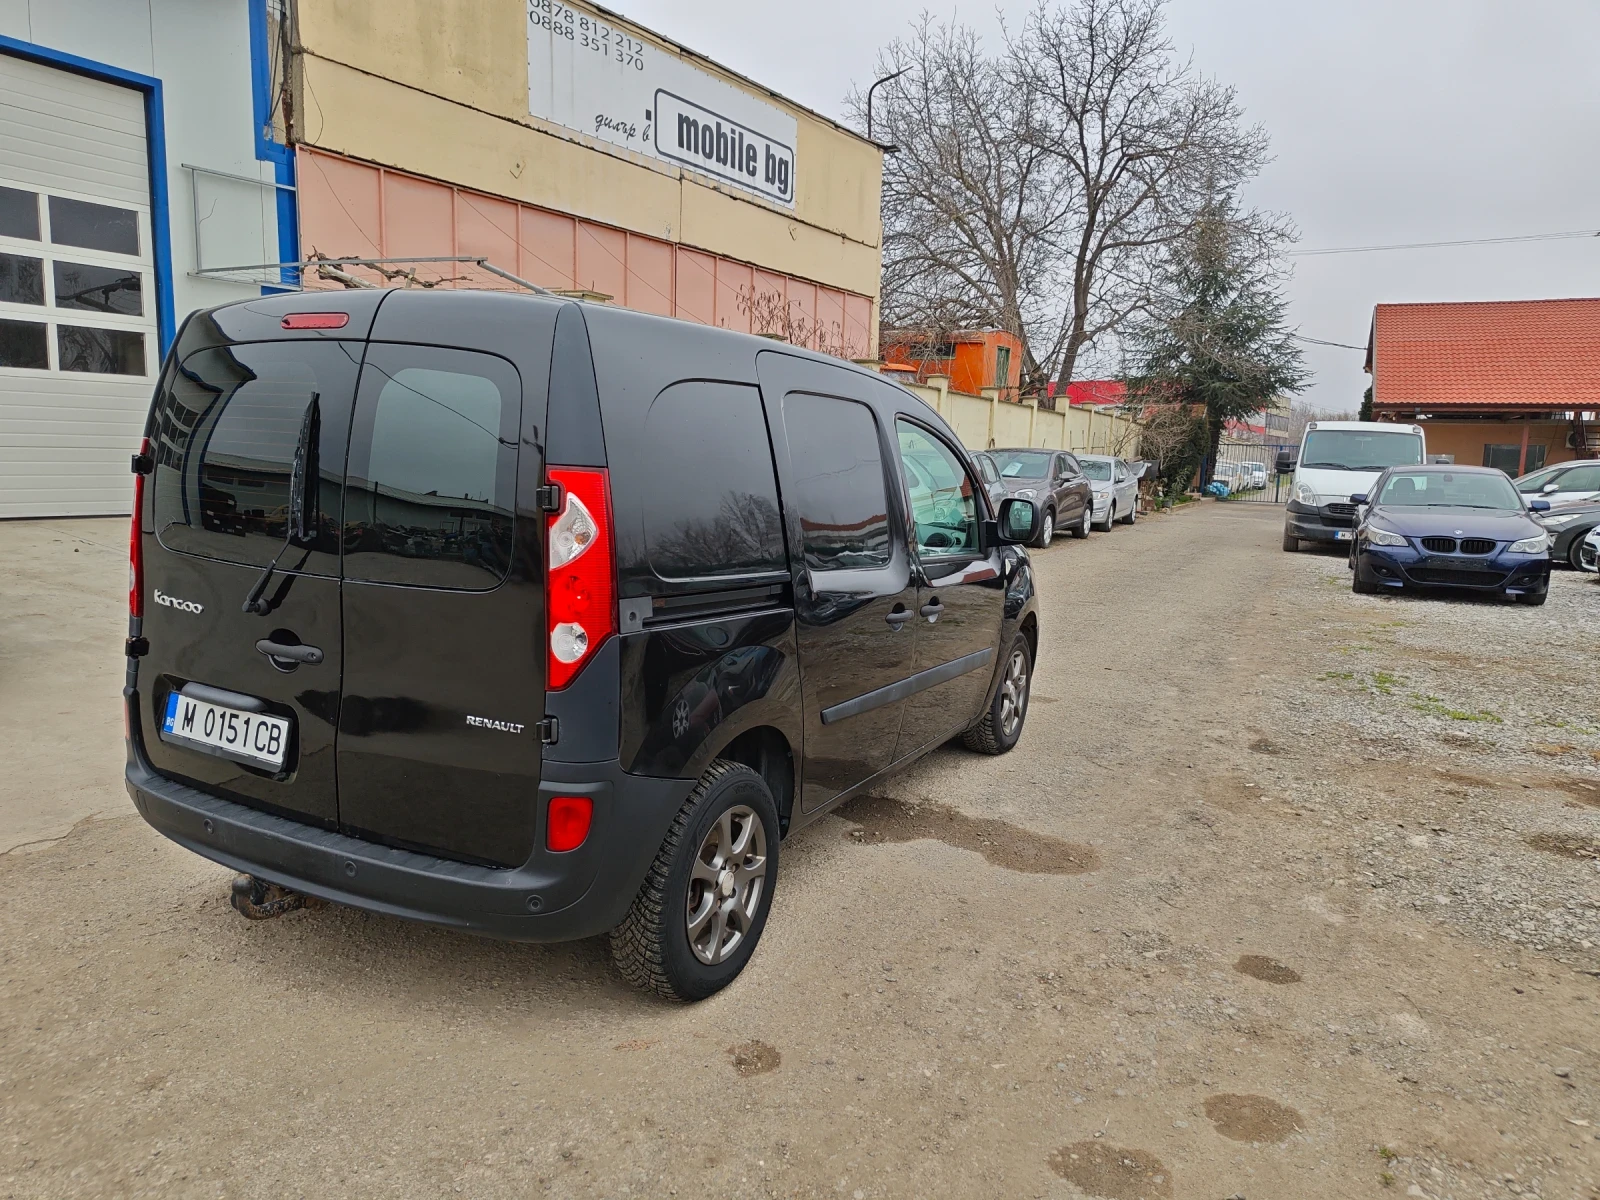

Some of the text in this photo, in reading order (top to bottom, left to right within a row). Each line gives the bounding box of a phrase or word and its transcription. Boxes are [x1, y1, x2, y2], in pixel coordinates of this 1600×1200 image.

[529, 0, 643, 56] 0878 812 212
[529, 10, 643, 70] 0888 351 370
[595, 114, 636, 141] дилър
[678, 112, 789, 195] mobile bg
[166, 716, 174, 726] BG
[181, 702, 197, 732] M
[466, 715, 525, 734] RENAULT
